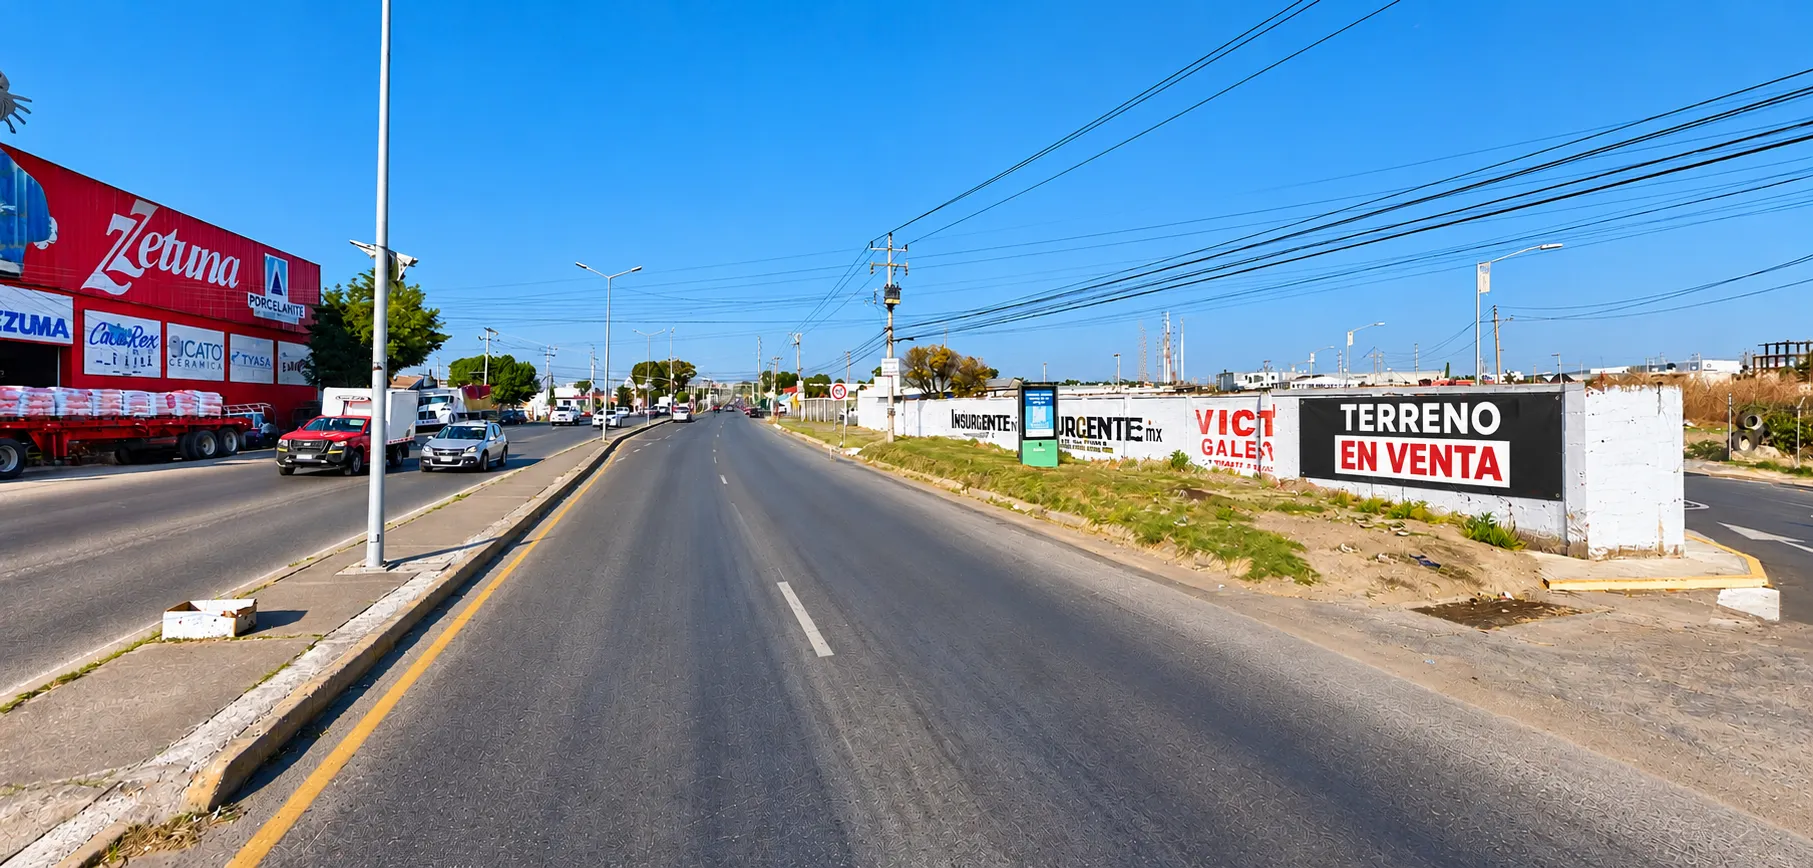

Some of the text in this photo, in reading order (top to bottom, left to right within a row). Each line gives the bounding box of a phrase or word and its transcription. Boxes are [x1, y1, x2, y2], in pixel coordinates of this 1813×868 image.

[0, 310, 70, 339] ZUMA
[241, 354, 271, 367] TYASA
[1340, 401, 1501, 436] TERRENO
[1341, 440, 1503, 482] EN VENTA
